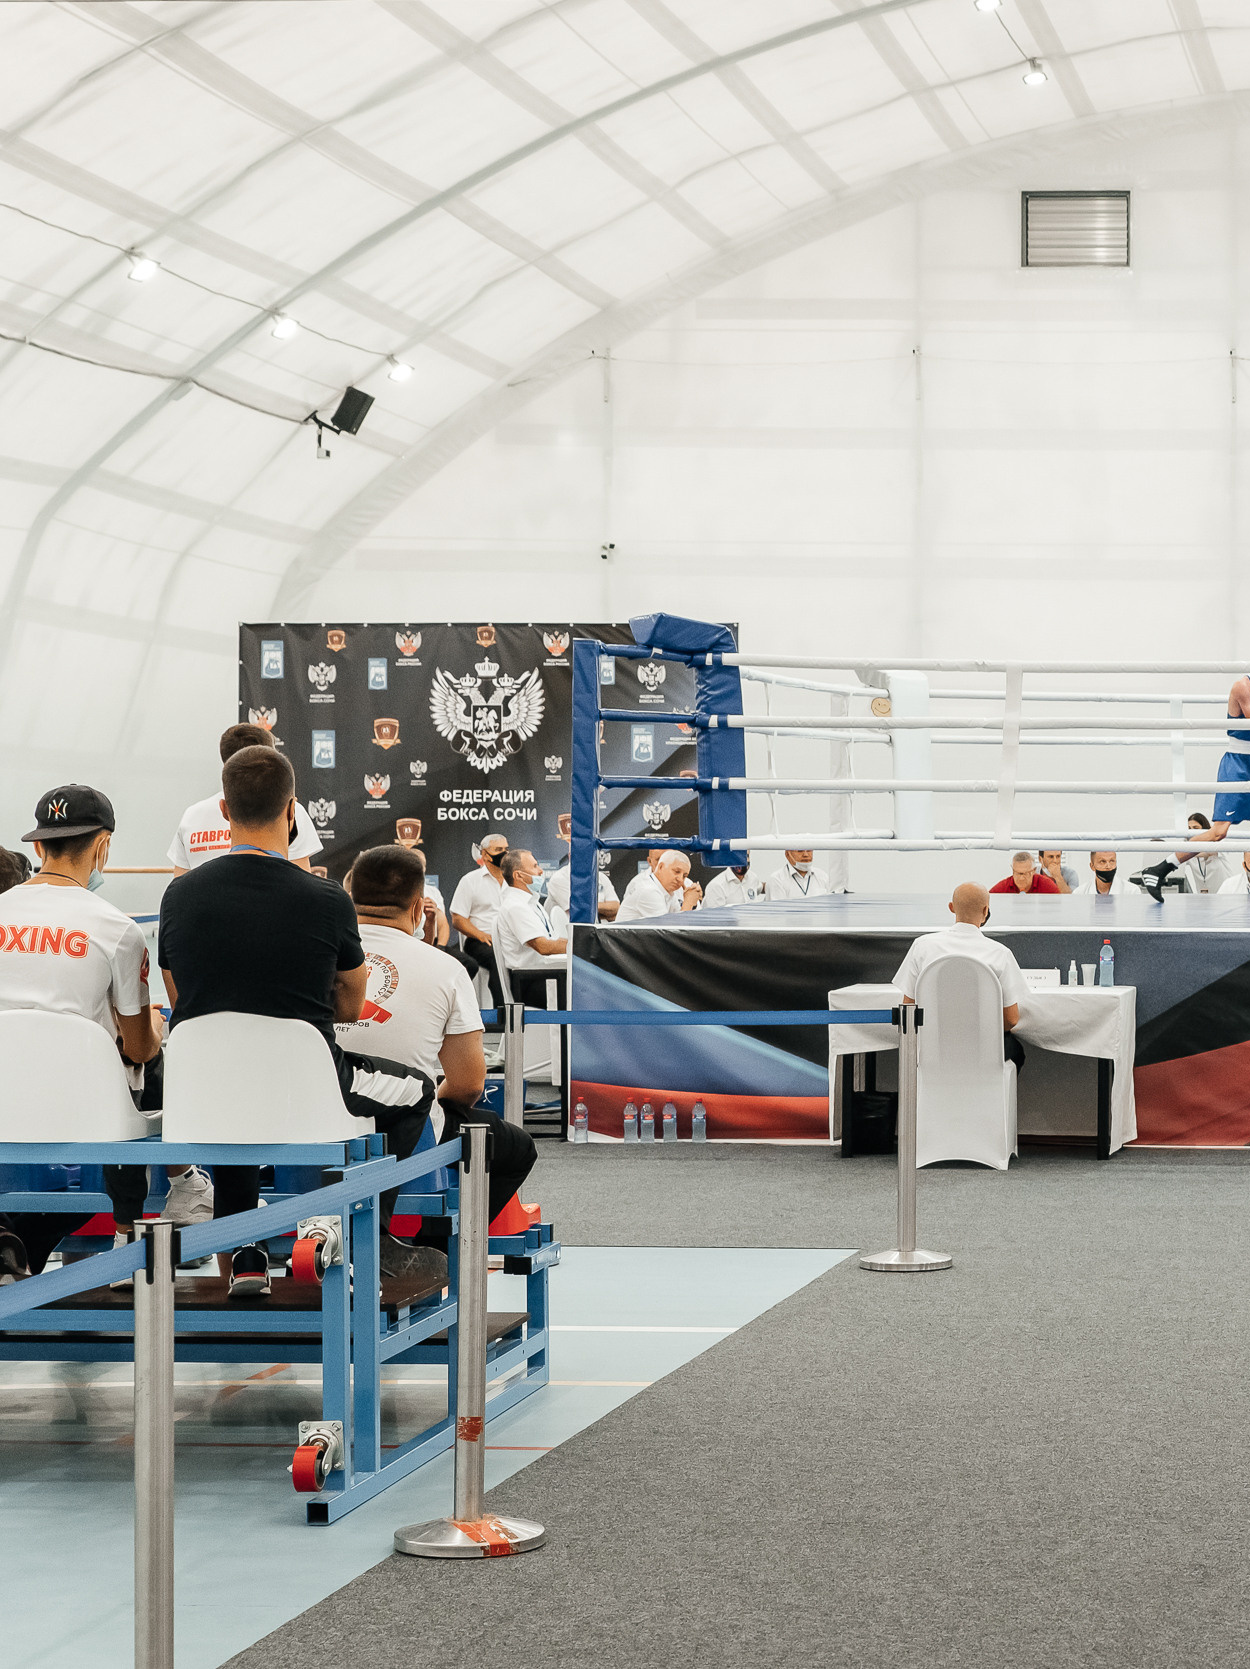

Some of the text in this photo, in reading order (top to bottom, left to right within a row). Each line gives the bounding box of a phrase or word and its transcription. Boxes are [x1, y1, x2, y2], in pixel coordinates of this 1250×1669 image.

[439, 789, 535, 805] ФЕДЕРАЦИЯ
[437, 807, 537, 822] БОКСА СОЧИ
